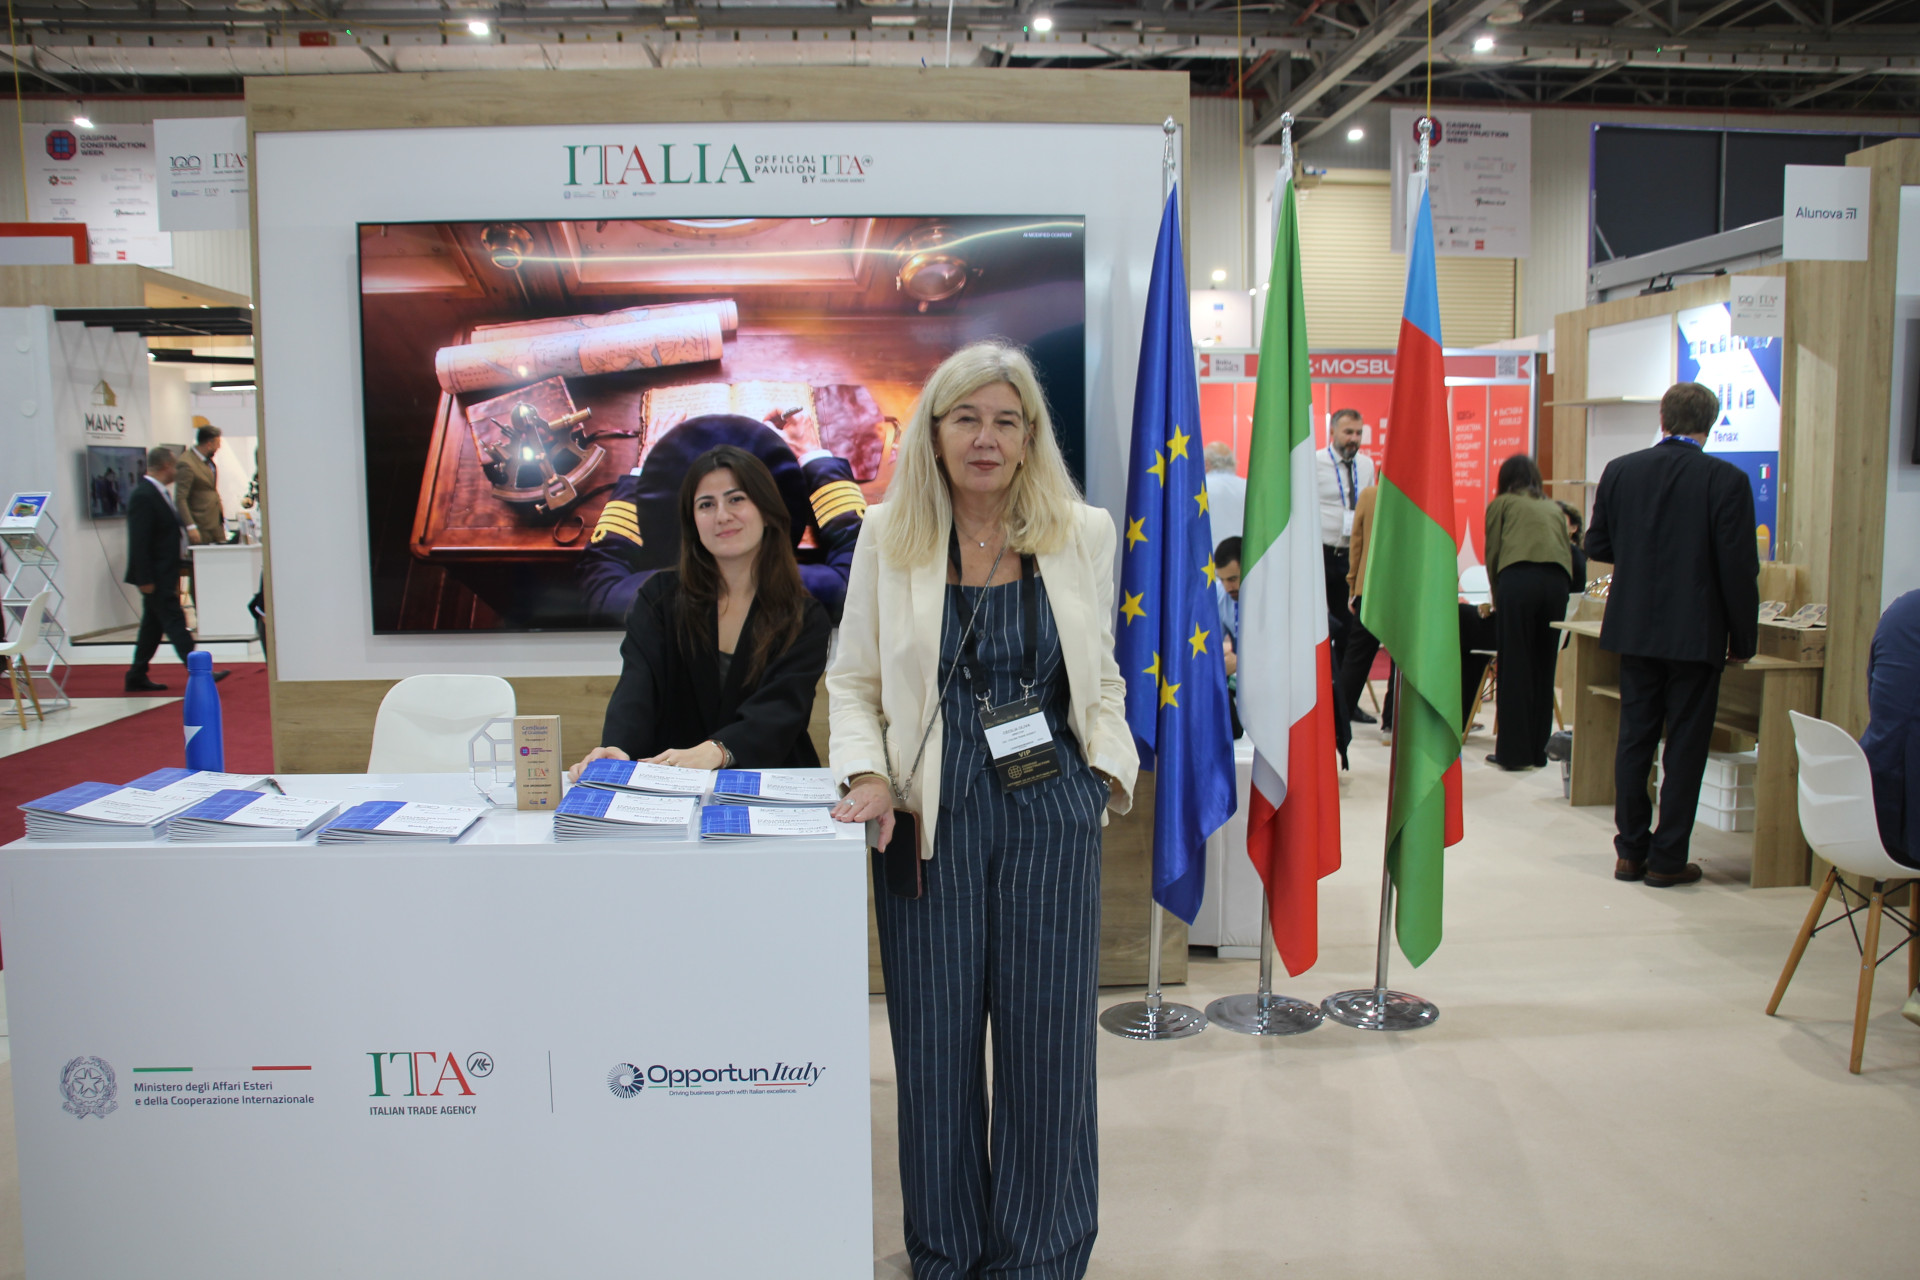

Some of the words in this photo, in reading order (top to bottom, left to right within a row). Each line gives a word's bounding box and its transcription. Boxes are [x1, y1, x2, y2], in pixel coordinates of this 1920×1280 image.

[212, 152, 245, 168] ITA
[562, 143, 755, 186] ITALIA
[754, 155, 816, 164] OFFICIAL
[821, 154, 865, 175] ITA
[754, 165, 816, 174] PAVILION
[801, 175, 816, 184] BY
[1795, 206, 1843, 219] Alunova
[1321, 359, 1396, 375] MOSBU
[84, 412, 124, 432] MAN-G
[1714, 431, 1738, 441] Tenax
[1019, 749, 1031, 758] VIP
[366, 1052, 476, 1096] ITA
[647, 1062, 826, 1087] OpportunItaly
[134, 1083, 182, 1092] Ministero
[185, 1082, 209, 1093] degli
[212, 1081, 240, 1091] Affari
[243, 1081, 273, 1091] Esteri
[144, 1096, 168, 1105] della
[171, 1095, 239, 1107] Cooperazione
[242, 1094, 314, 1104] Internazionale
[369, 1107, 405, 1116] ITALIAN
[407, 1106, 438, 1115] TRADE
[440, 1106, 477, 1115] AGENCY
